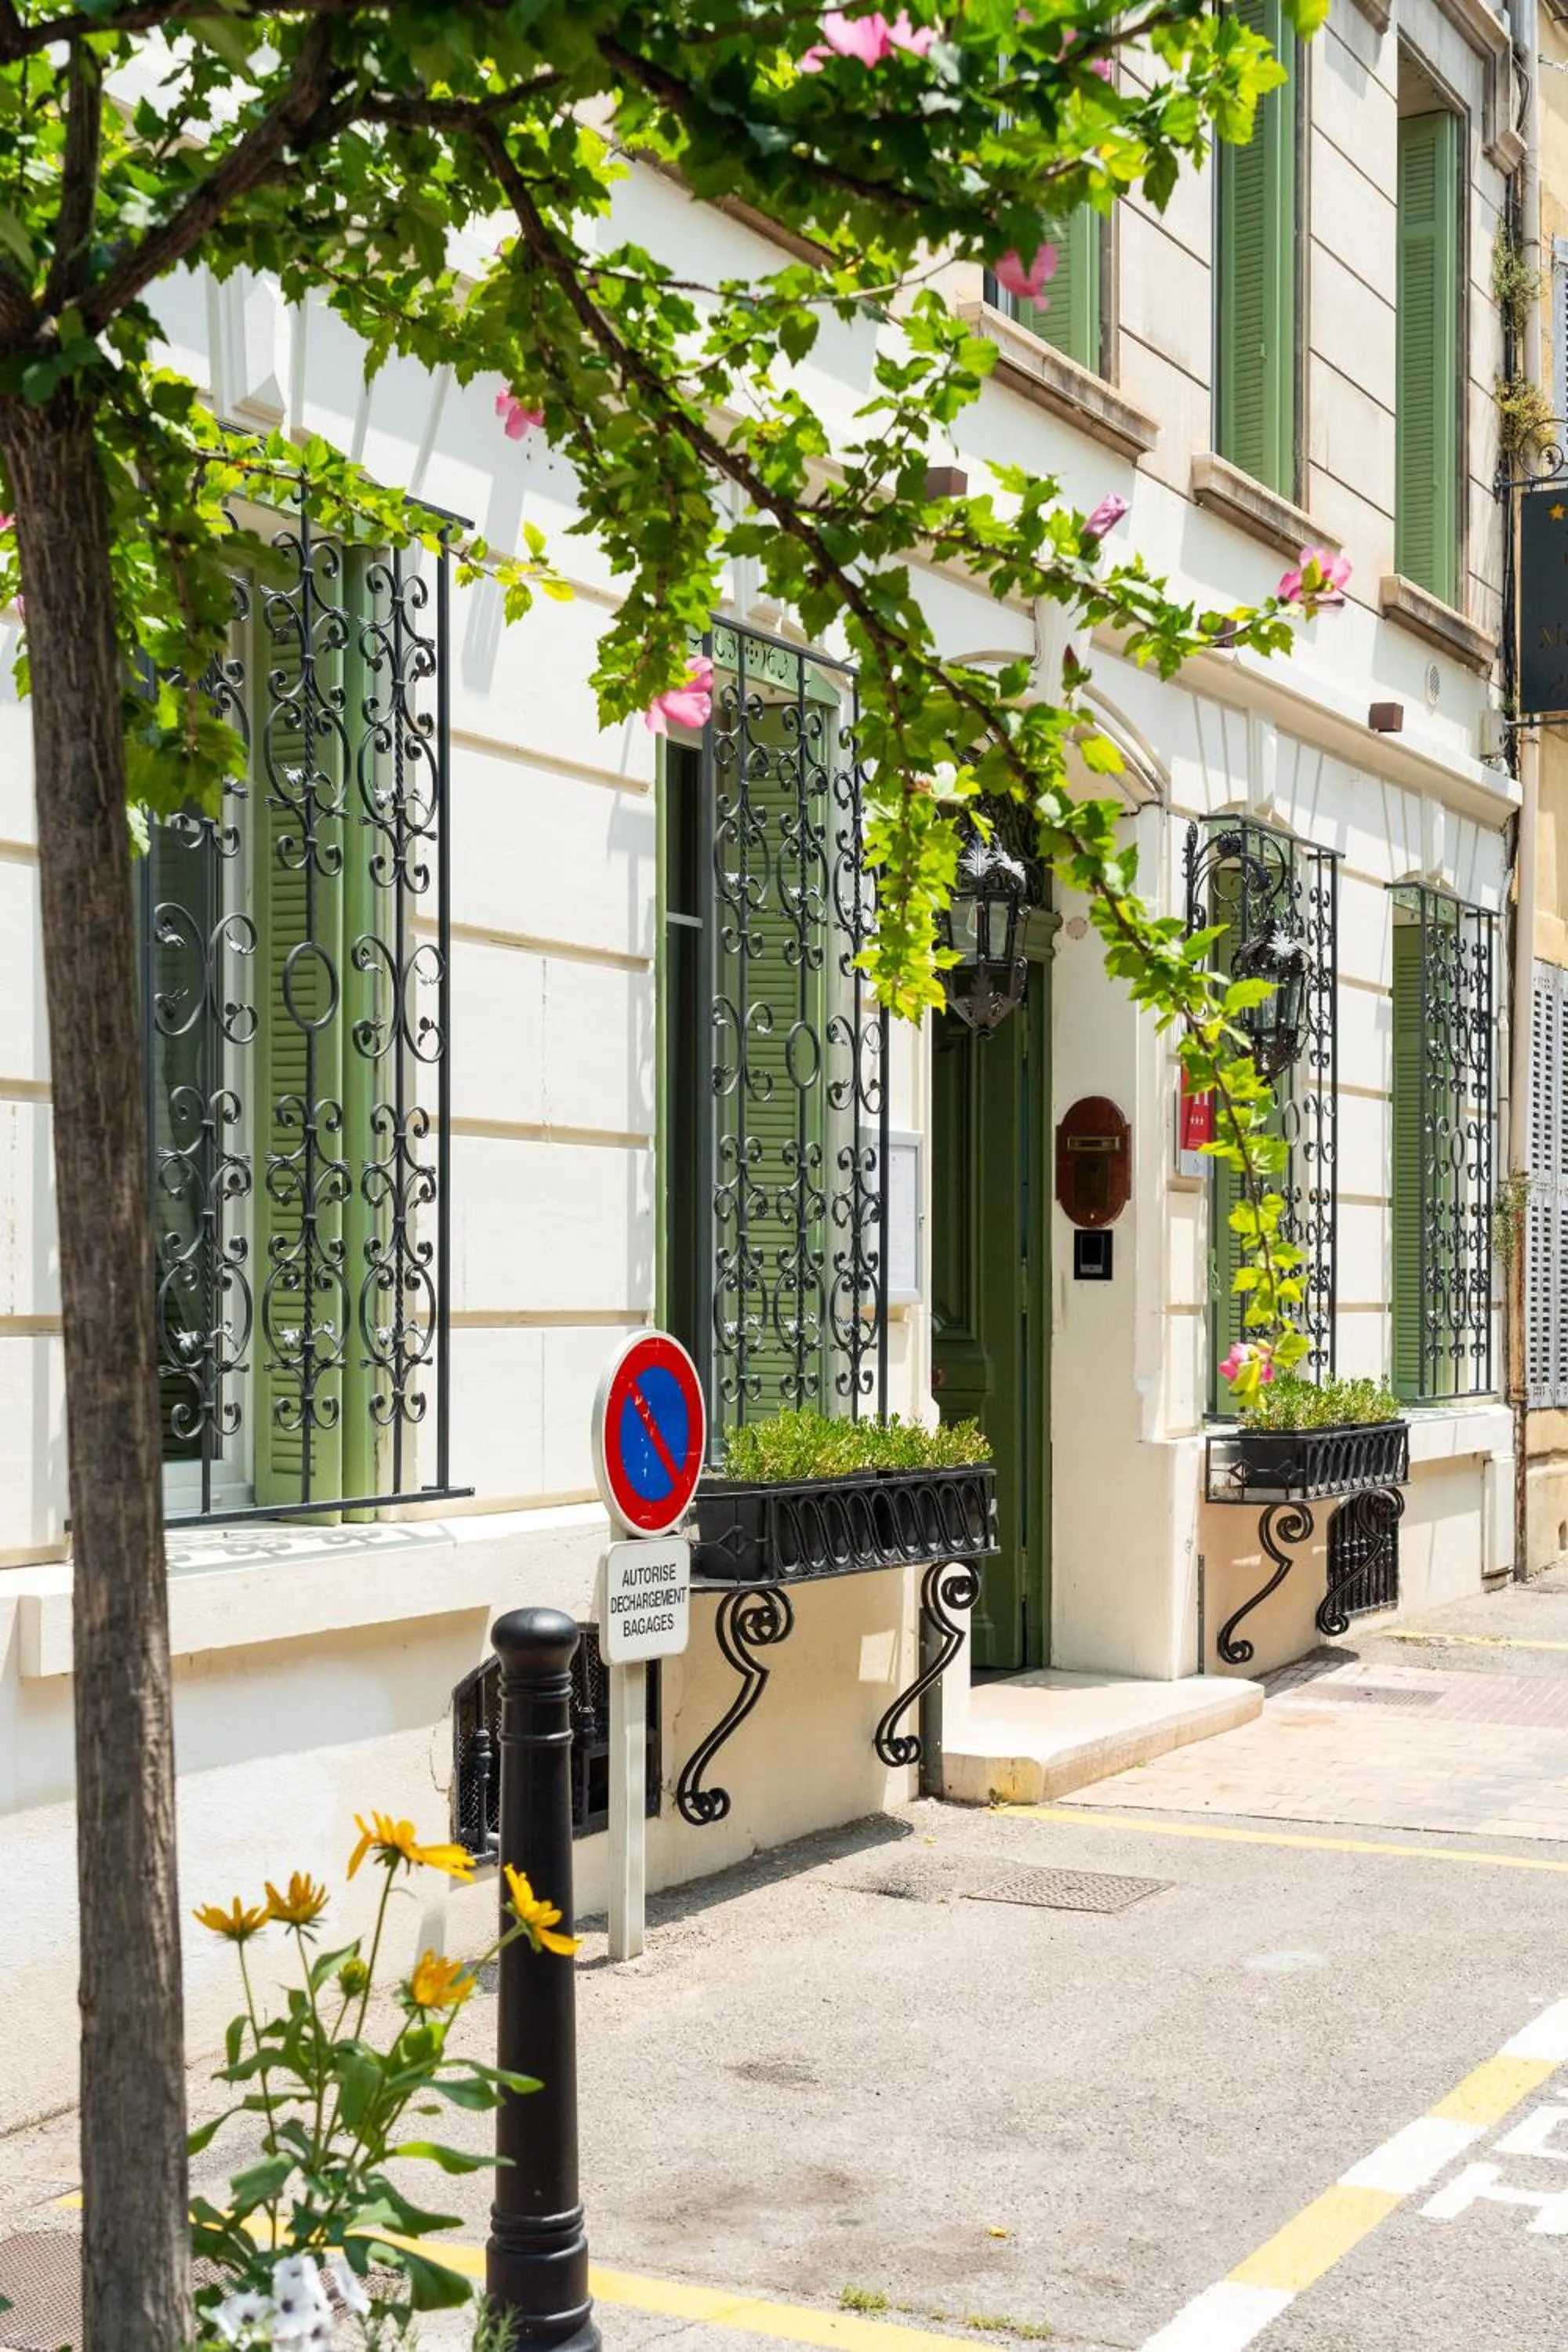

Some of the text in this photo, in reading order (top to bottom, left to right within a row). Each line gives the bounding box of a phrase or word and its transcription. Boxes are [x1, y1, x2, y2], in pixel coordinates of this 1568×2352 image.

[622, 1563, 677, 1587] AUTORISE
[611, 1586, 688, 1613] DECHARGEMENT
[623, 1613, 675, 1637] BAGAGES
